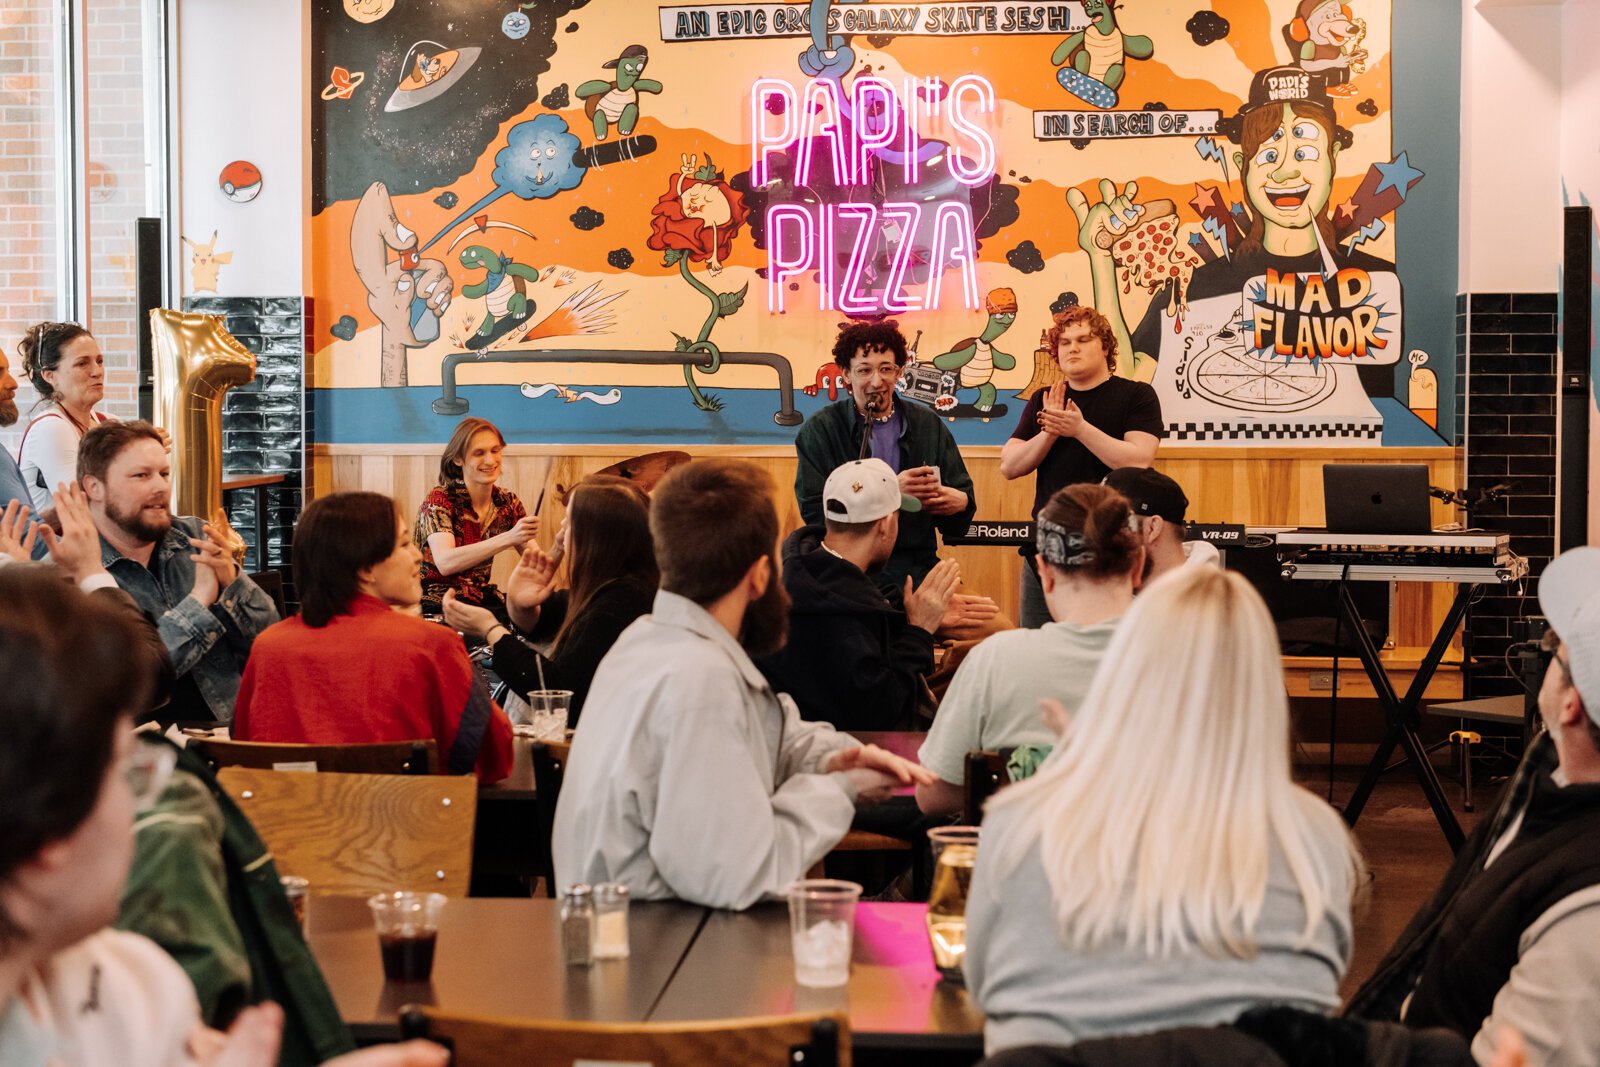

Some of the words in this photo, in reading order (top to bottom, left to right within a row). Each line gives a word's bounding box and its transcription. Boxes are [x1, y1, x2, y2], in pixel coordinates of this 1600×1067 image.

[675, 10, 710, 38] AN
[717, 8, 767, 35] EPIC
[773, 7, 842, 32] CROS
[843, 7, 921, 32] GALAXY
[924, 6, 997, 32] SKATE
[1268, 88, 1309, 101] WORLD
[751, 74, 995, 187] PAPI'S
[1043, 114, 1070, 136] IN
[1073, 113, 1154, 136] SEARCH
[767, 201, 980, 313] PIZZA
[1266, 267, 1371, 314] MAD
[1253, 303, 1388, 360] FLAVOR
[1410, 352, 1424, 362] MC
[978, 524, 1029, 538] Roland
[1201, 530, 1239, 540] VR-09
